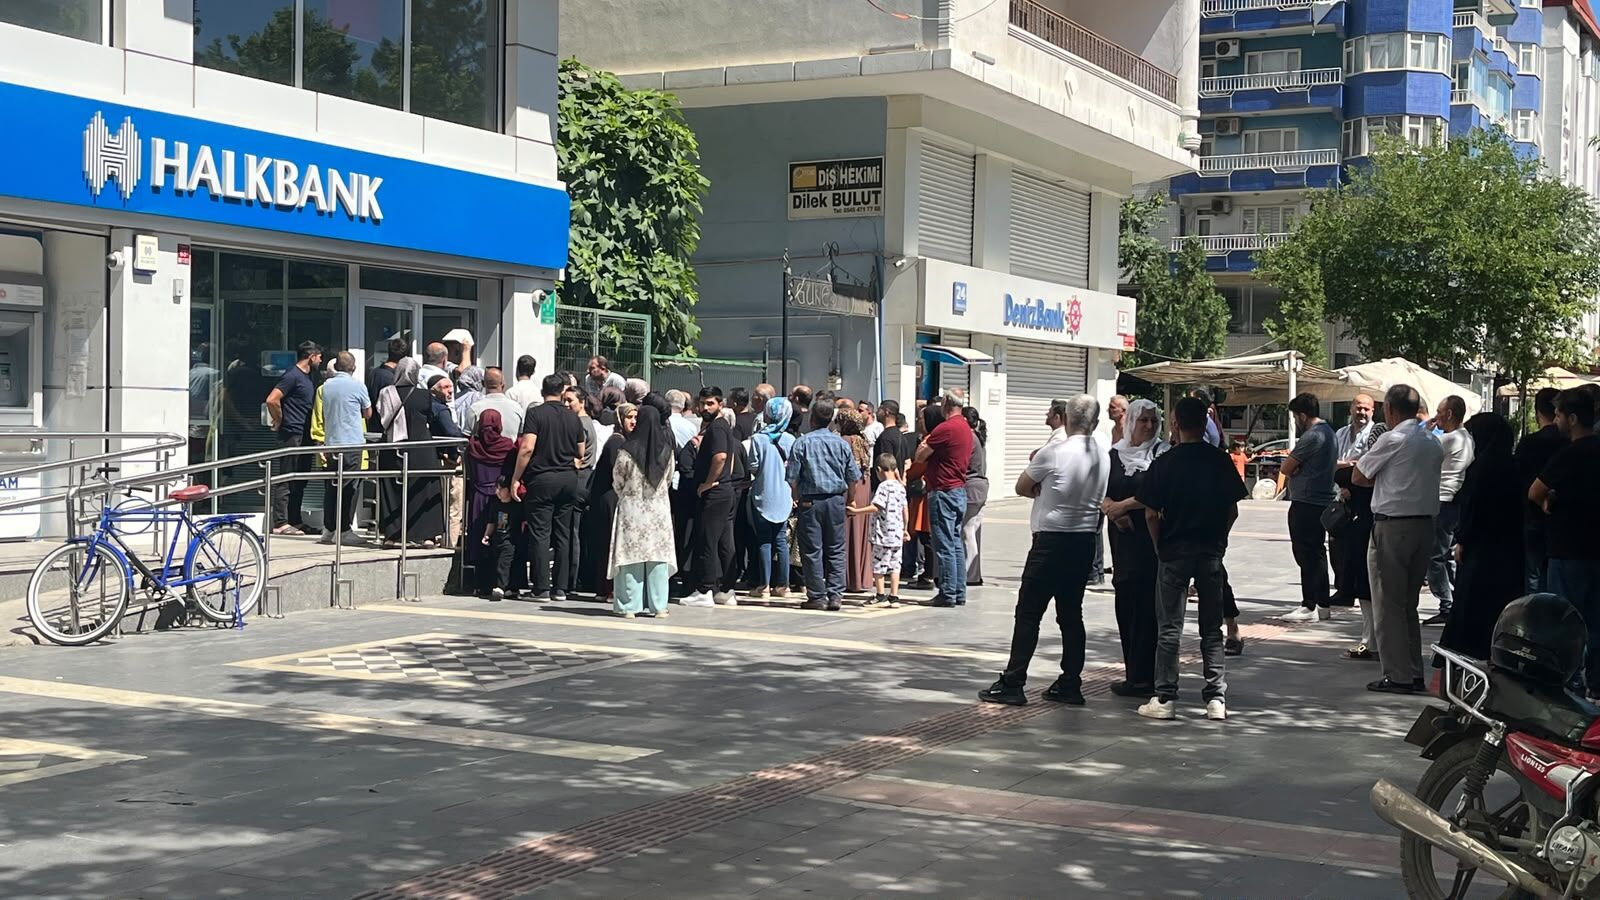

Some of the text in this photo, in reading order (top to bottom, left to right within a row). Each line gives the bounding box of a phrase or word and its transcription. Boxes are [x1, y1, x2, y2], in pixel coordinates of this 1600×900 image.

[150, 137, 384, 220] HALKBANK
[793, 190, 881, 209] Dilek BULUT
[956, 285, 966, 300] 24
[1003, 293, 1065, 331] DenizBank
[1520, 753, 1546, 773] LION125
[1551, 842, 1575, 853] LIFAN
